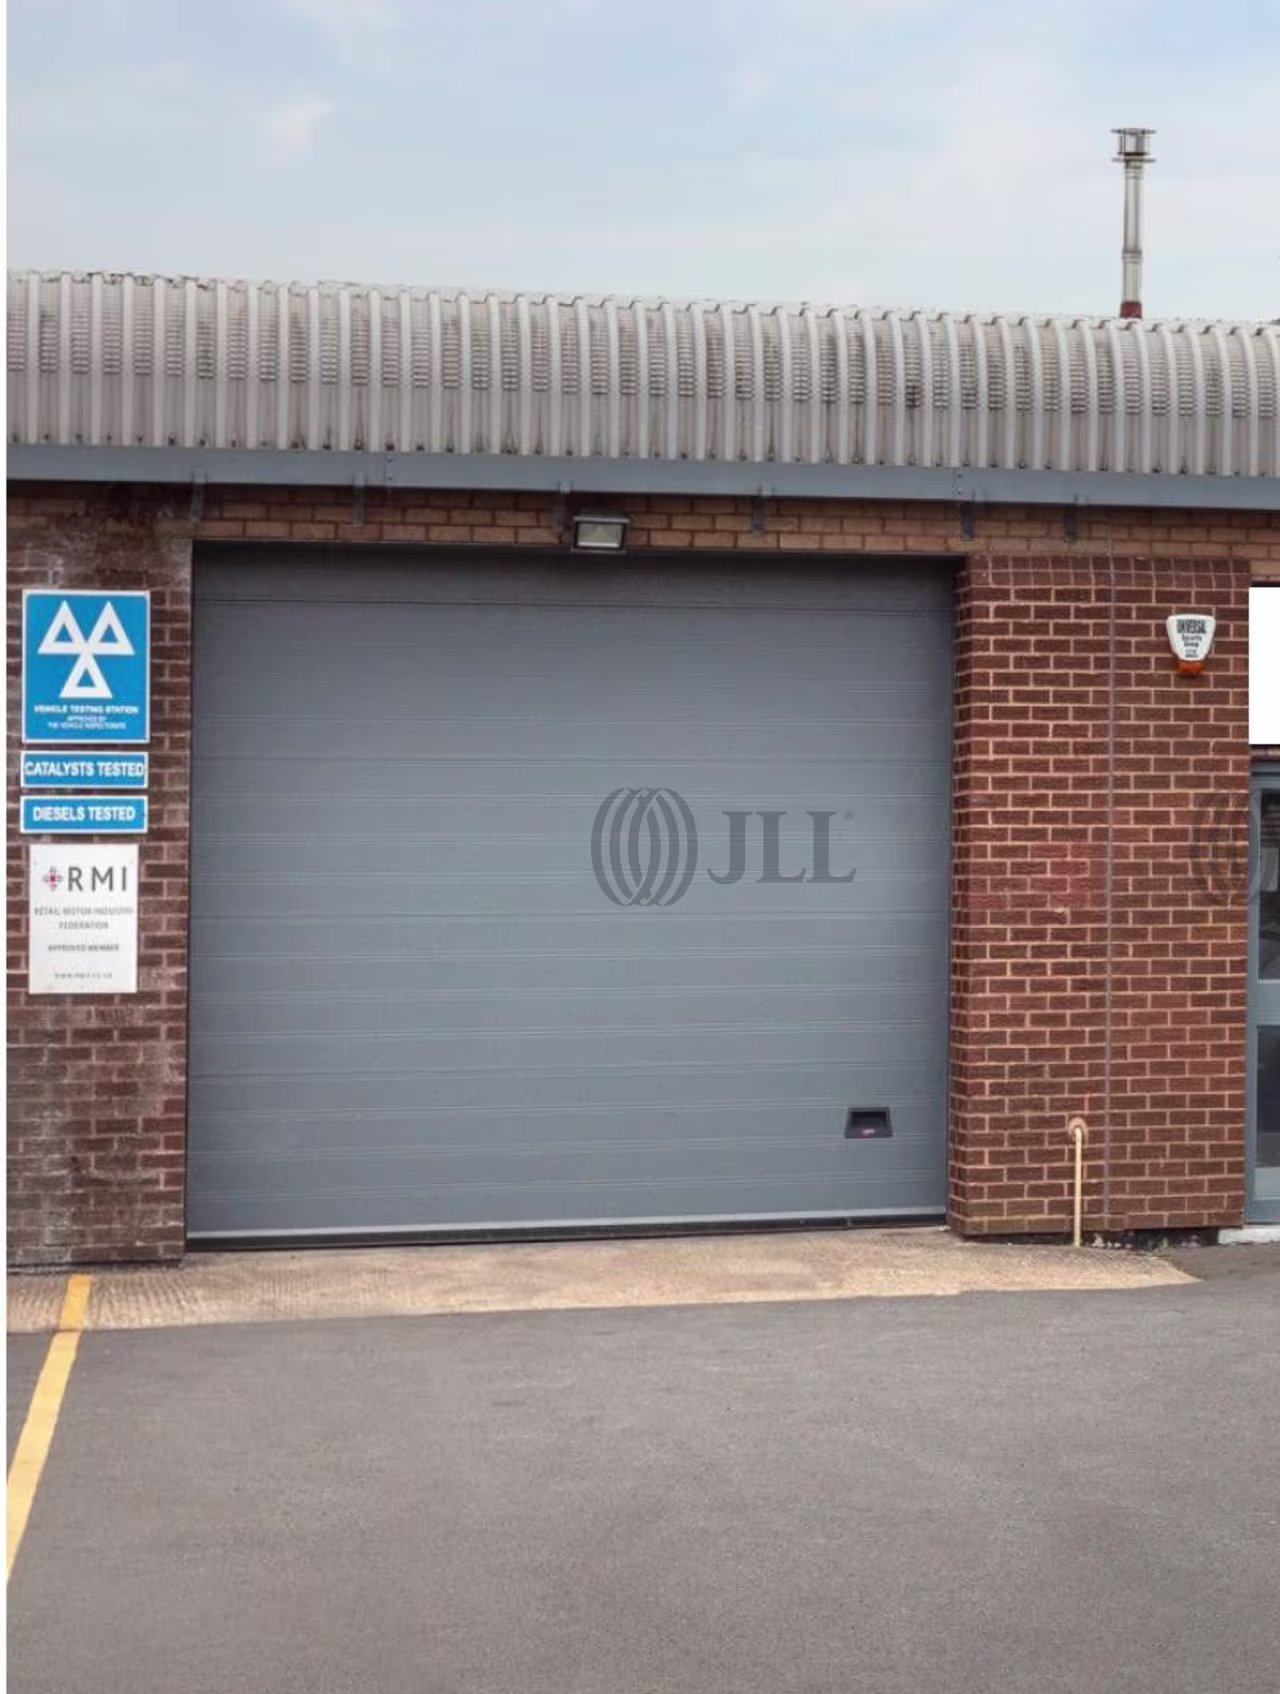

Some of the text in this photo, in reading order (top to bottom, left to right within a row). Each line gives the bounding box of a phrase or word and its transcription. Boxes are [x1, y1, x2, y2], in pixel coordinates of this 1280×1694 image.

[25, 761, 144, 777] CATALYSTS TESTED
[33, 805, 136, 821] DIESELS TESTED
[68, 866, 127, 892] RMI
